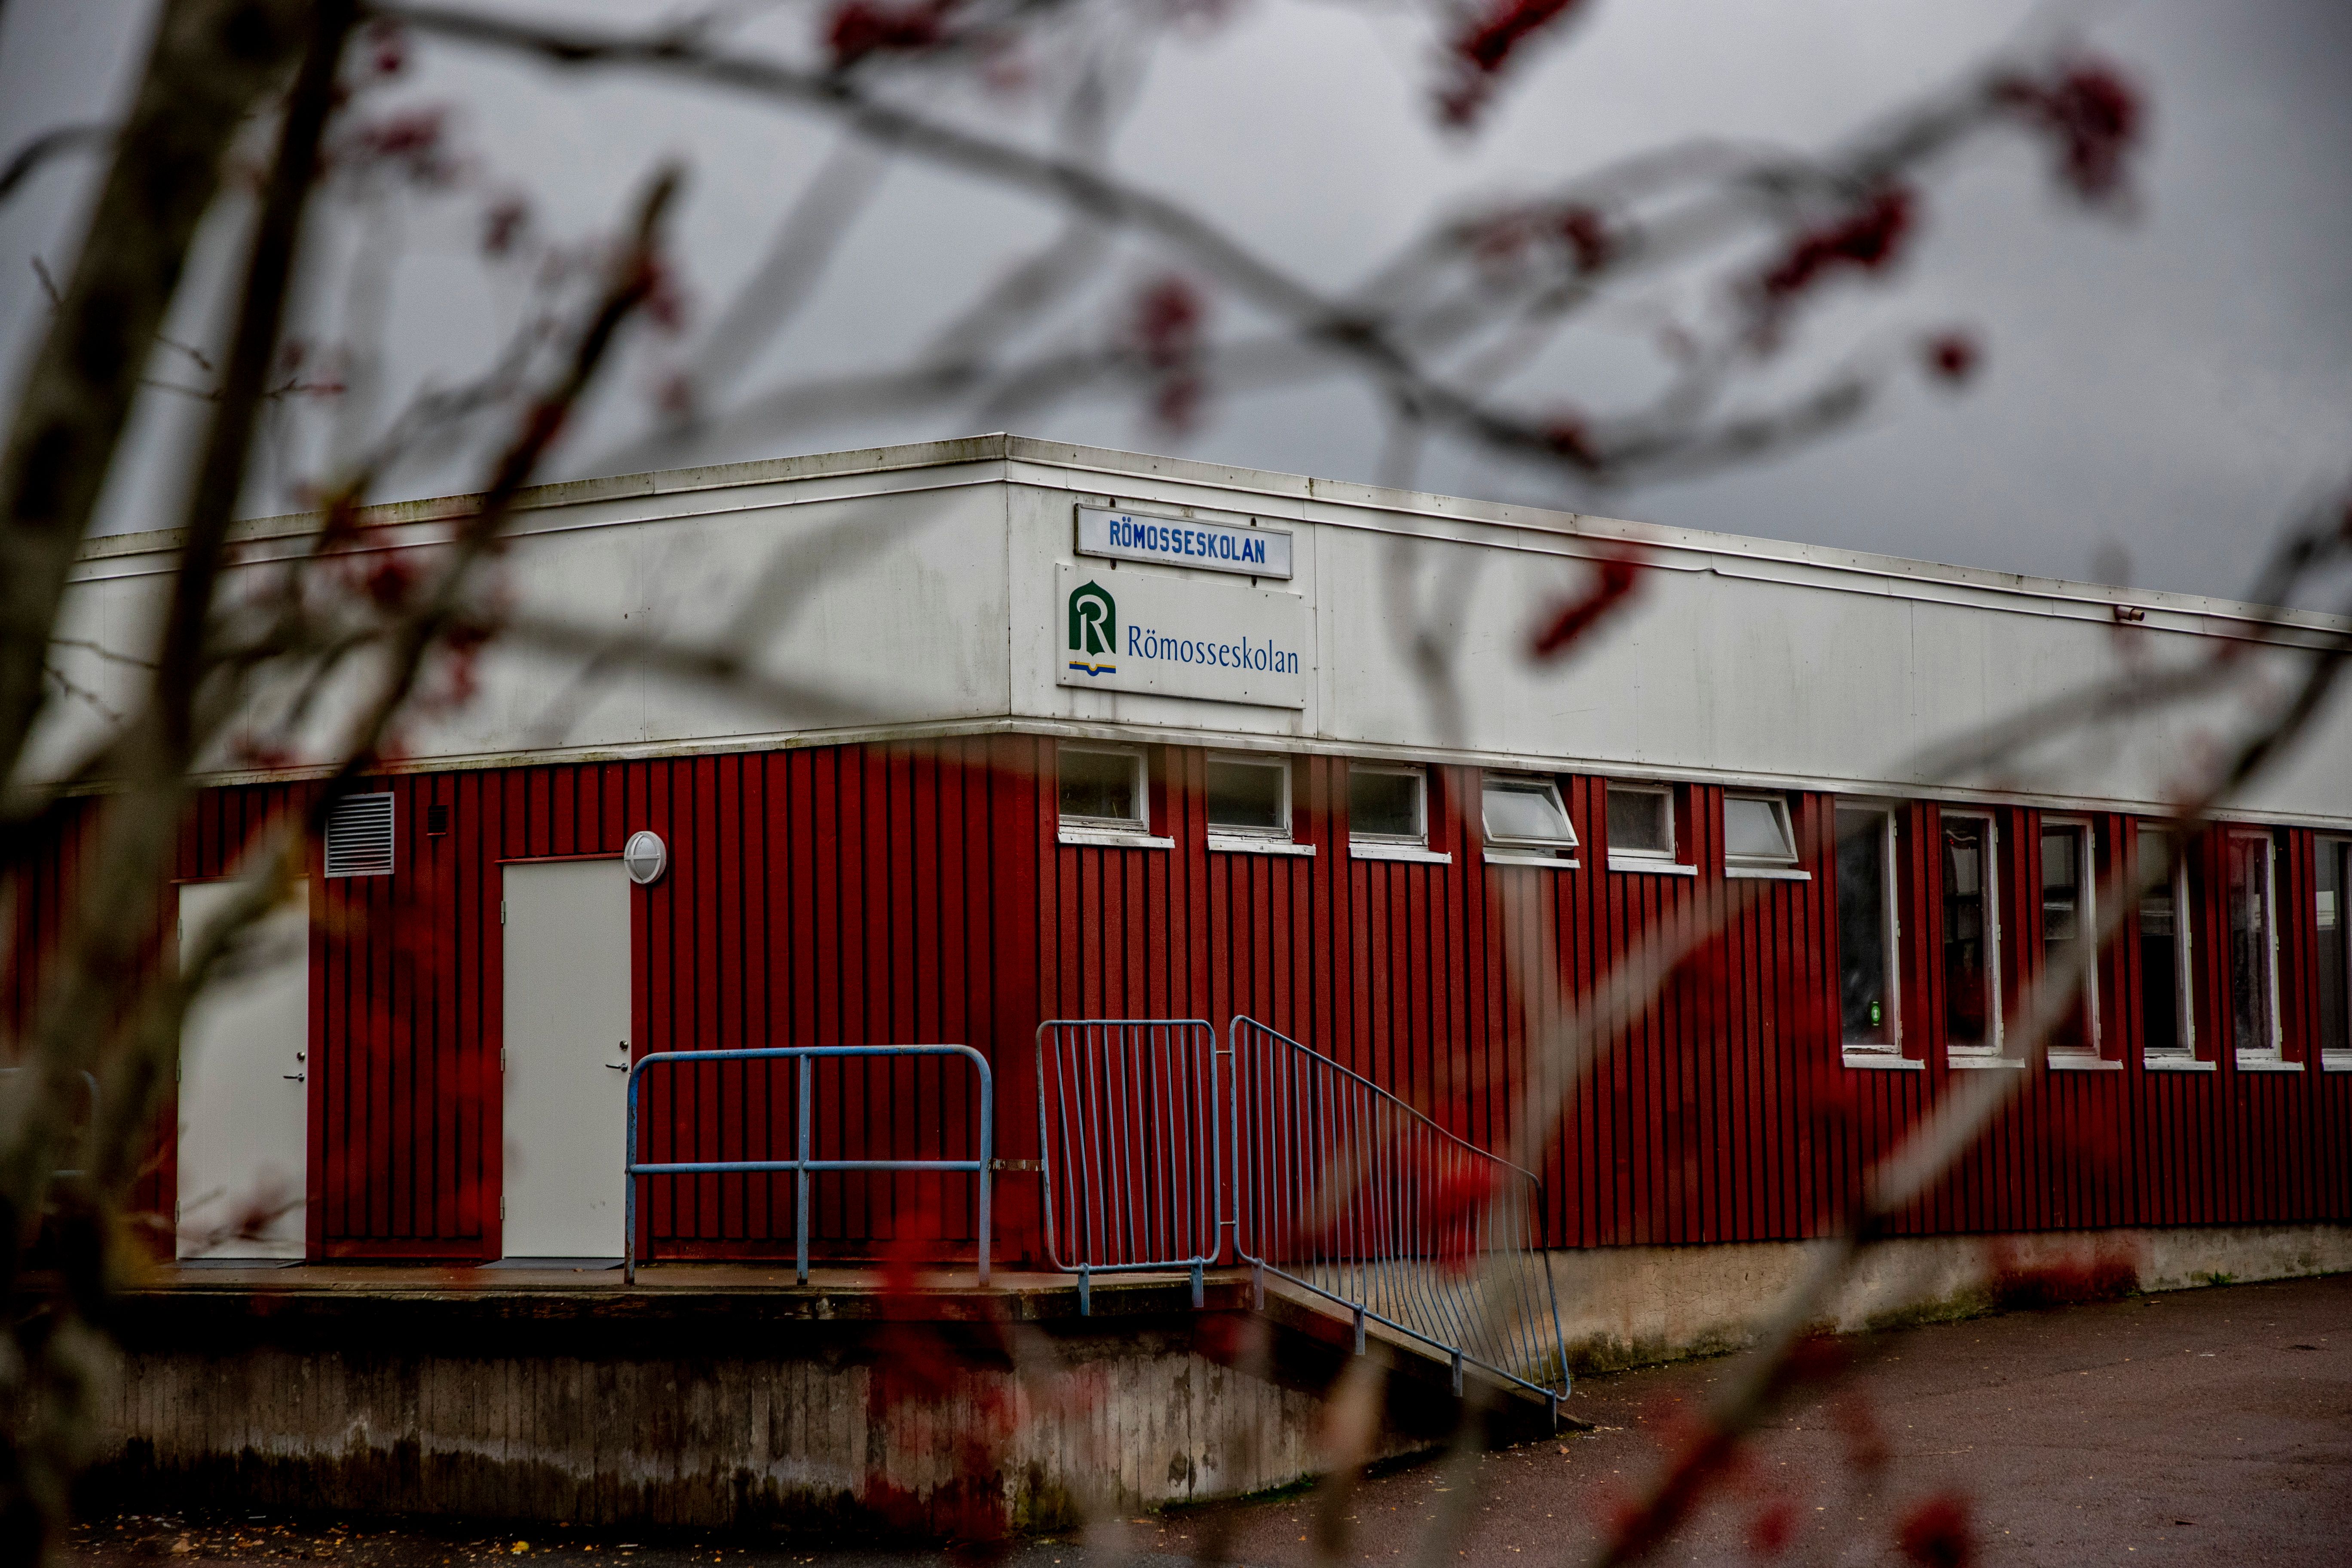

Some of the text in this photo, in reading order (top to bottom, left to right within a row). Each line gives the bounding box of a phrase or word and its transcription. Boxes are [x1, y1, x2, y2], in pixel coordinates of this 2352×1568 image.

[1110, 517, 1265, 563] RÖMOSSESKOLAN
[1076, 594, 1116, 654] R
[1128, 625, 1298, 674] Römosseskolan
